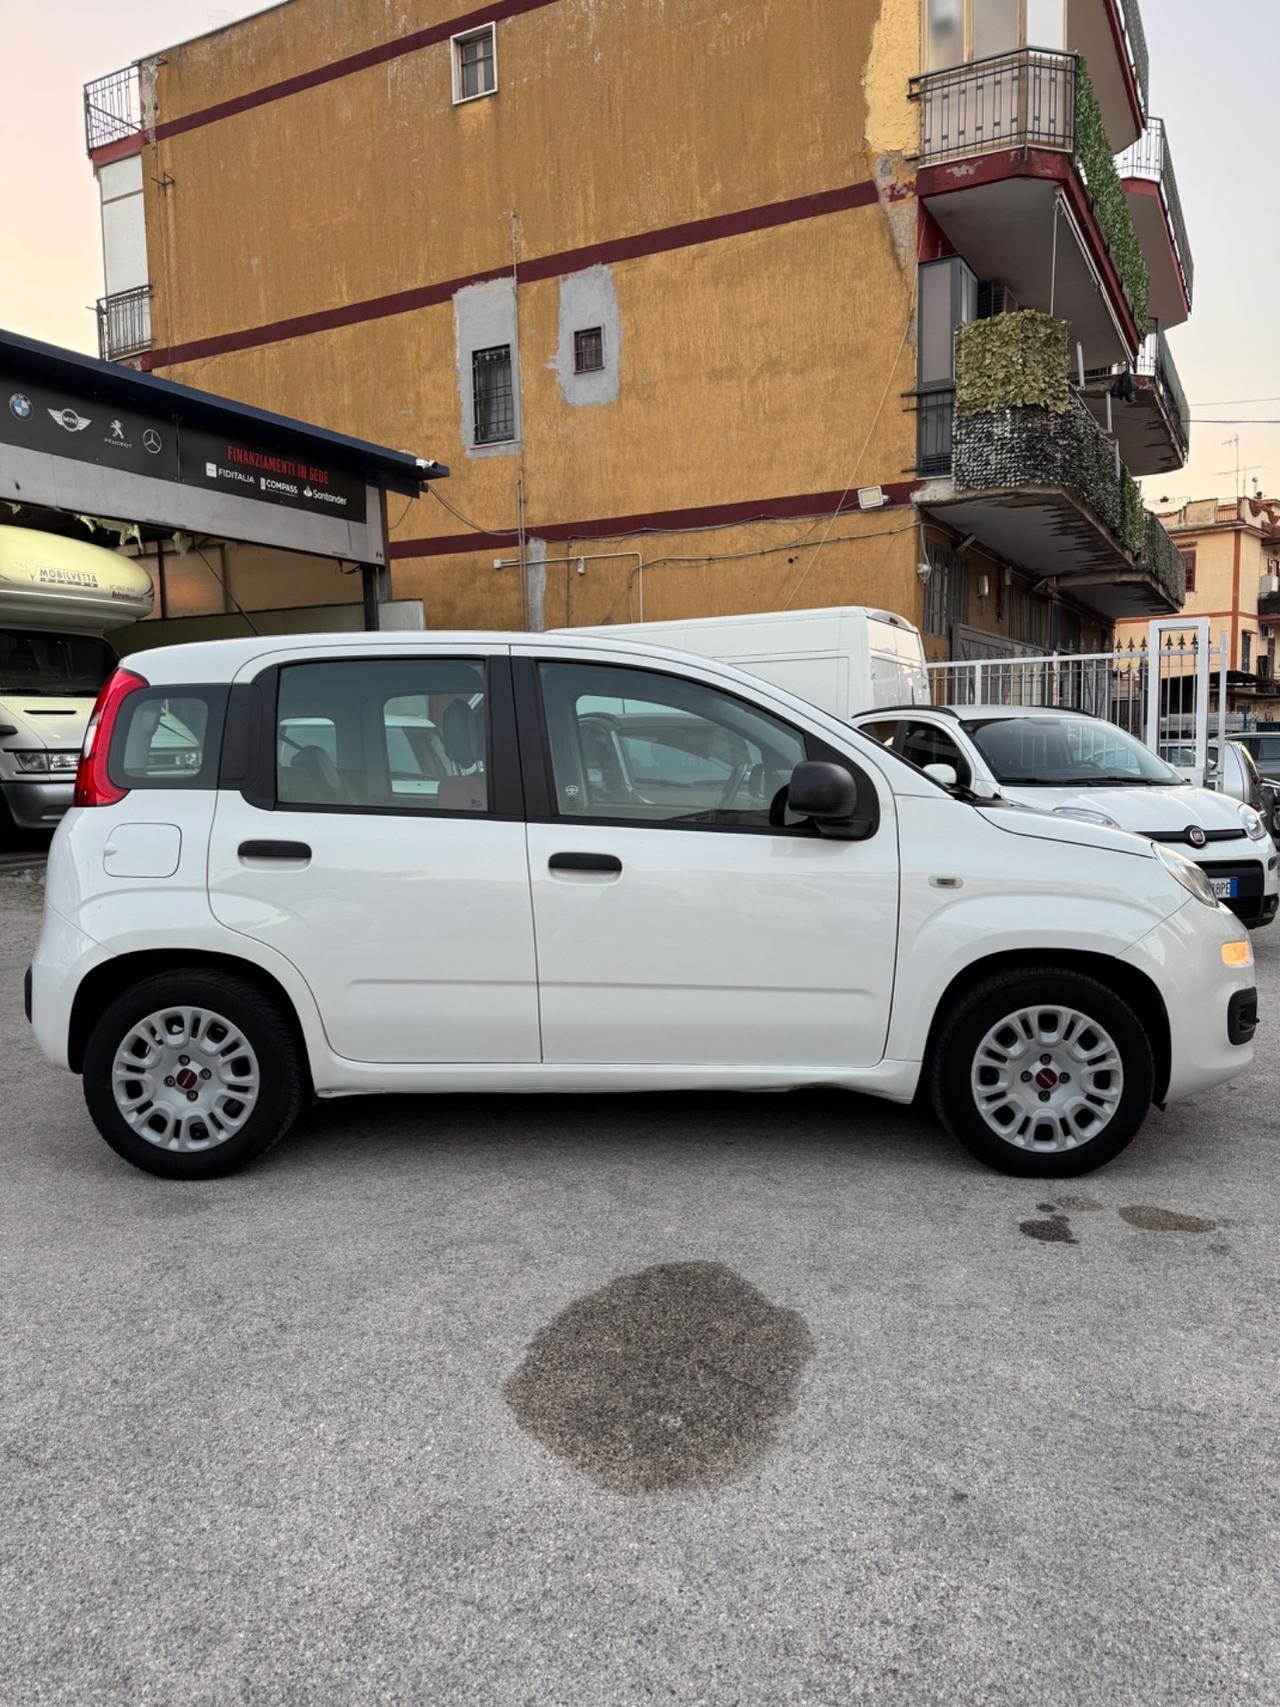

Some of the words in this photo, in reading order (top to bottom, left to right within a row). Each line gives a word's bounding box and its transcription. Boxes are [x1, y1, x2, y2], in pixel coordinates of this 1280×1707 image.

[63, 415, 78, 425] MINI
[227, 445, 295, 476] FINANZIAMENTI
[298, 464, 307, 479] IN
[309, 467, 329, 485] SEDE
[218, 468, 255, 484] FIDITALIA
[266, 479, 299, 494] COMPASS
[313, 489, 347, 505] Santander
[40, 569, 98, 583] MOBILVETTA
